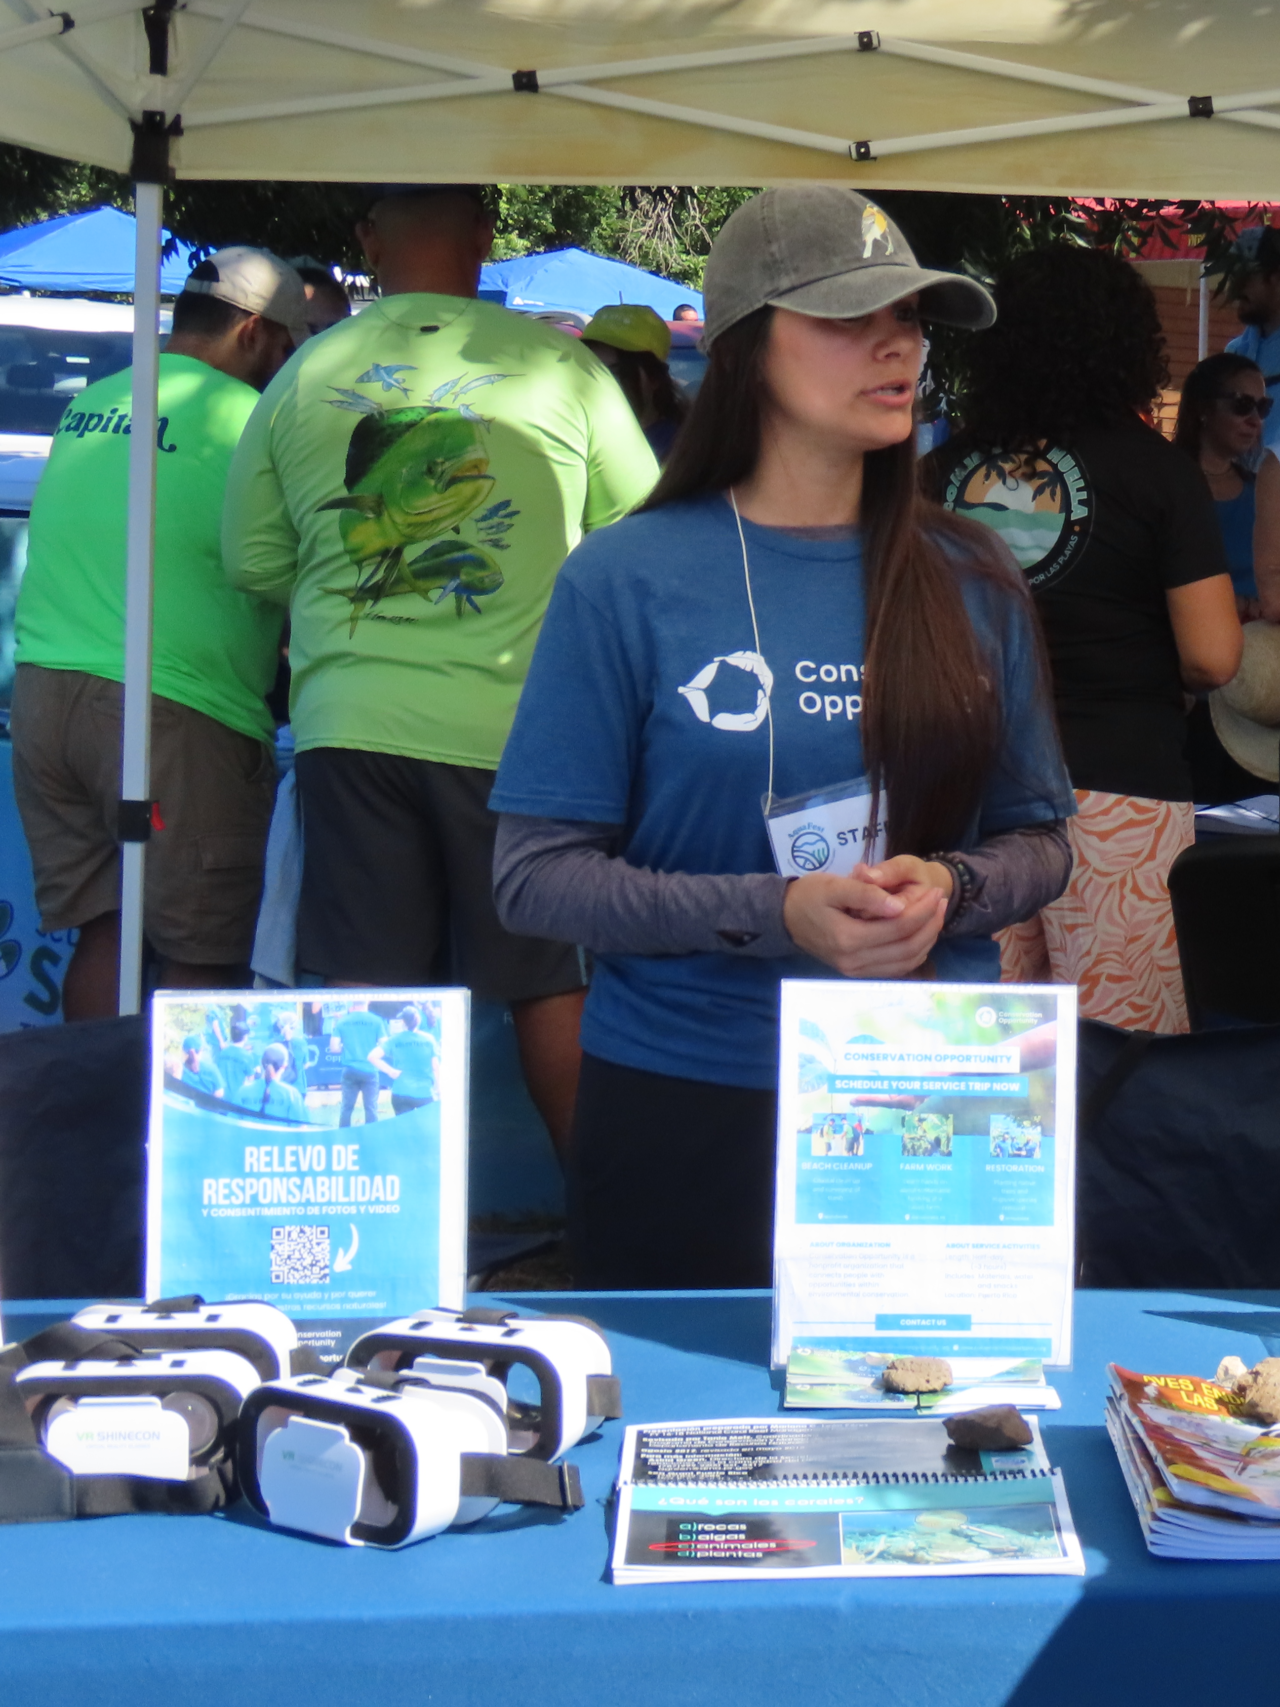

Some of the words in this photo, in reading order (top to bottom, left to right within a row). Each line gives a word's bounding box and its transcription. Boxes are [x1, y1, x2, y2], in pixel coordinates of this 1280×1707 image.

[1046, 446, 1089, 521] HUELLA
[1045, 563, 1061, 577] LAS
[1057, 534, 1079, 566] PLAYAS
[843, 1052, 932, 1063] CONSERVATION
[934, 1053, 1013, 1064] OPPORTUNITY
[834, 1079, 890, 1091] SCHEDULE
[890, 1079, 921, 1091] YOUR
[922, 1080, 966, 1092] SERVICE
[967, 1081, 991, 1092] TRIP
[992, 1082, 1020, 1093] NOW
[245, 1144, 327, 1173] RELEVO
[332, 1143, 360, 1171] DE
[801, 1161, 831, 1171] BEACH
[833, 1162, 873, 1171] CLEANUP
[899, 1162, 924, 1171] FARM
[926, 1163, 953, 1171] WORK
[985, 1163, 1045, 1173] RESTORATION
[202, 1174, 401, 1206] RESPONSABILIDAD
[202, 1207, 210, 1218] Y
[211, 1206, 305, 1217] CONSENTIMIENTO
[306, 1205, 321, 1215] DE
[322, 1205, 357, 1215] FOTOS
[358, 1204, 367, 1215] Y
[368, 1203, 401, 1214] VIDEO
[835, 1241, 892, 1249] ORGANIZATION
[264, 1292, 279, 1302] por
[293, 1290, 322, 1301] ayuda
[331, 1290, 345, 1301] por
[899, 1318, 936, 1327] CONTACT
[936, 1318, 948, 1327] US
[1180, 1391, 1219, 1411] LAS
[76, 1430, 94, 1441] VR
[97, 1430, 161, 1441] SHINECON
[657, 1496, 710, 1507] ¿Qué
[715, 1498, 749, 1507] son
[753, 1497, 779, 1506] los
[784, 1496, 865, 1507] corales?
